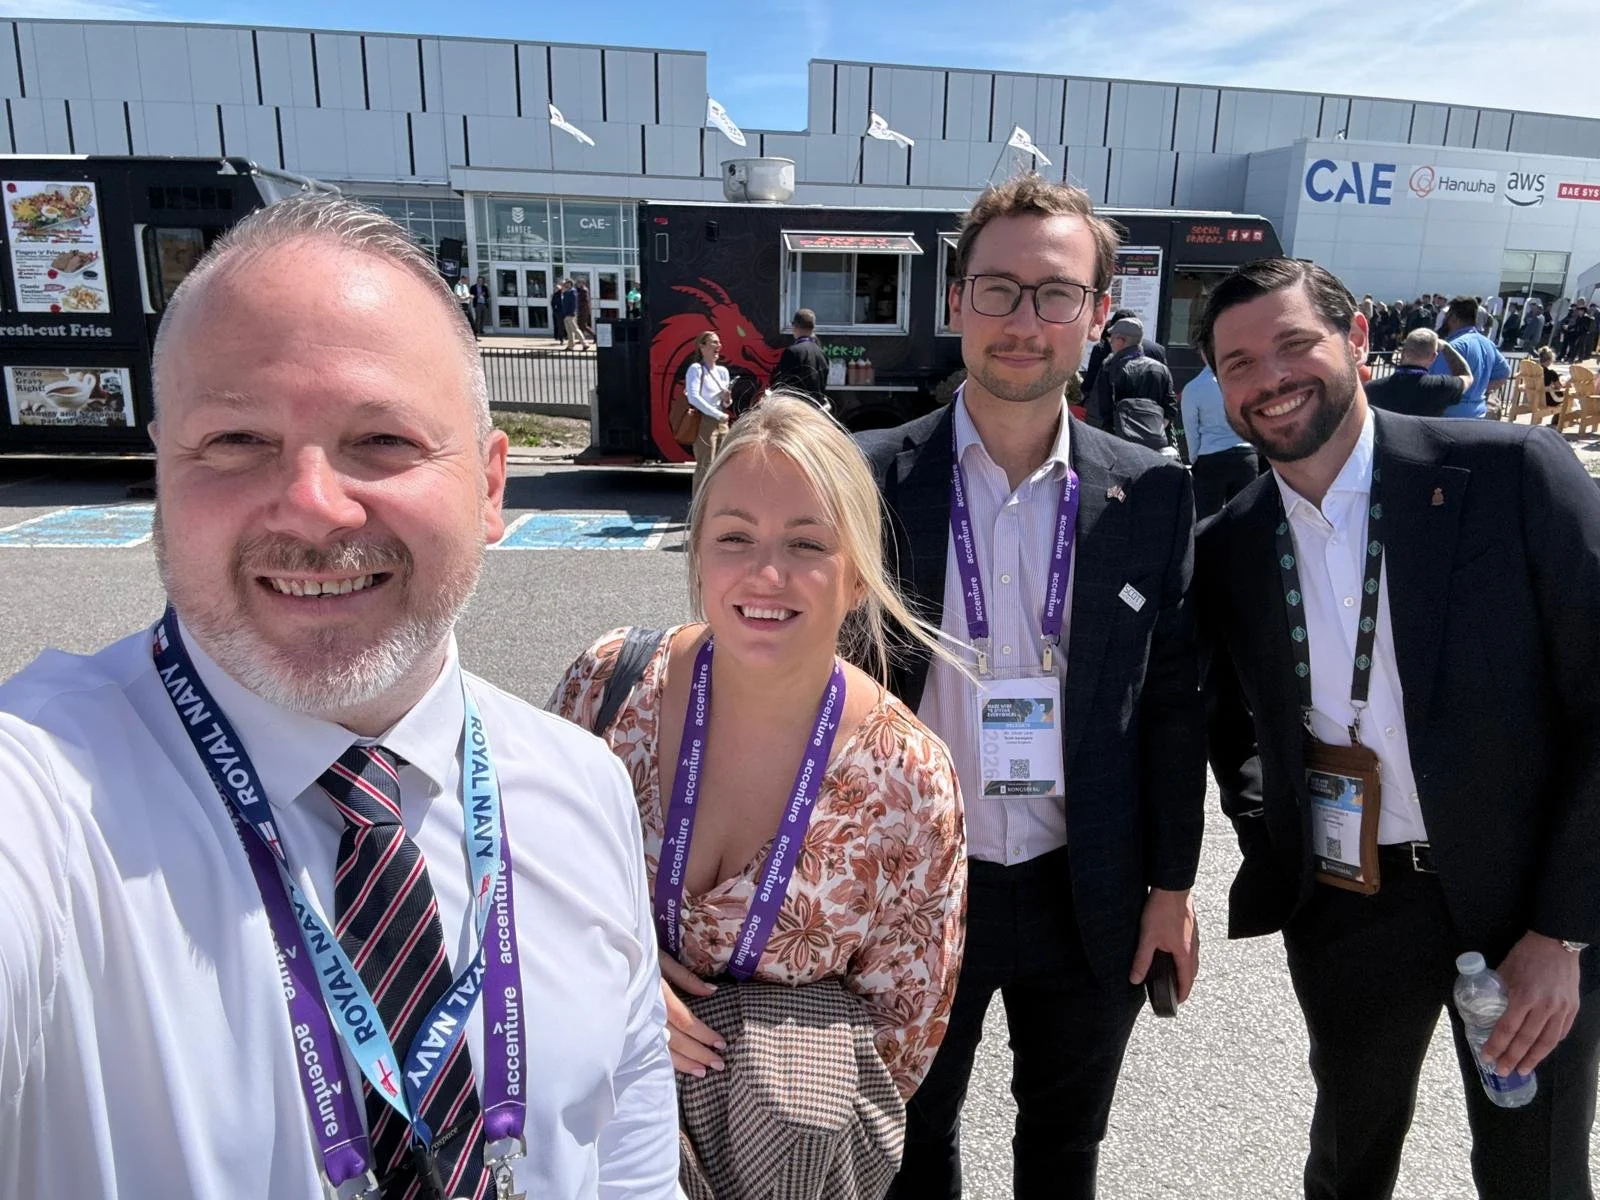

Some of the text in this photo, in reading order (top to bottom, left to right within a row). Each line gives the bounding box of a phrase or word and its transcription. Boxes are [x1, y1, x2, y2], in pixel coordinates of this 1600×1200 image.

[1305, 159, 1396, 205] CAE
[1438, 176, 1496, 194] Hanwha
[1507, 172, 1546, 192] aws
[1561, 186, 1600, 198] BAE SYS
[0, 323, 112, 337] resh-cut Fries
[952, 464, 965, 507] accenture
[1063, 473, 1072, 502] enture
[961, 520, 975, 564] accenture
[1056, 515, 1067, 559] accenture
[970, 576, 983, 622] accenture
[1047, 572, 1060, 617] accenture
[159, 662, 212, 728] NAVY
[695, 663, 709, 726] accenture
[813, 684, 838, 747] accenture
[201, 730, 259, 806] ROYAL
[469, 714, 494, 858] ROYAL NAVY
[684, 739, 702, 804] accenture
[788, 758, 815, 824] accenture
[670, 818, 690, 885] accenture
[760, 835, 790, 903] accenture
[494, 860, 513, 965] accenture
[735, 914, 761, 967] accenture
[289, 884, 378, 1047] ROYAL NAVY
[407, 947, 486, 1089] YAL NAVY
[504, 986, 519, 1096] accenture
[294, 1023, 339, 1138] accenture
